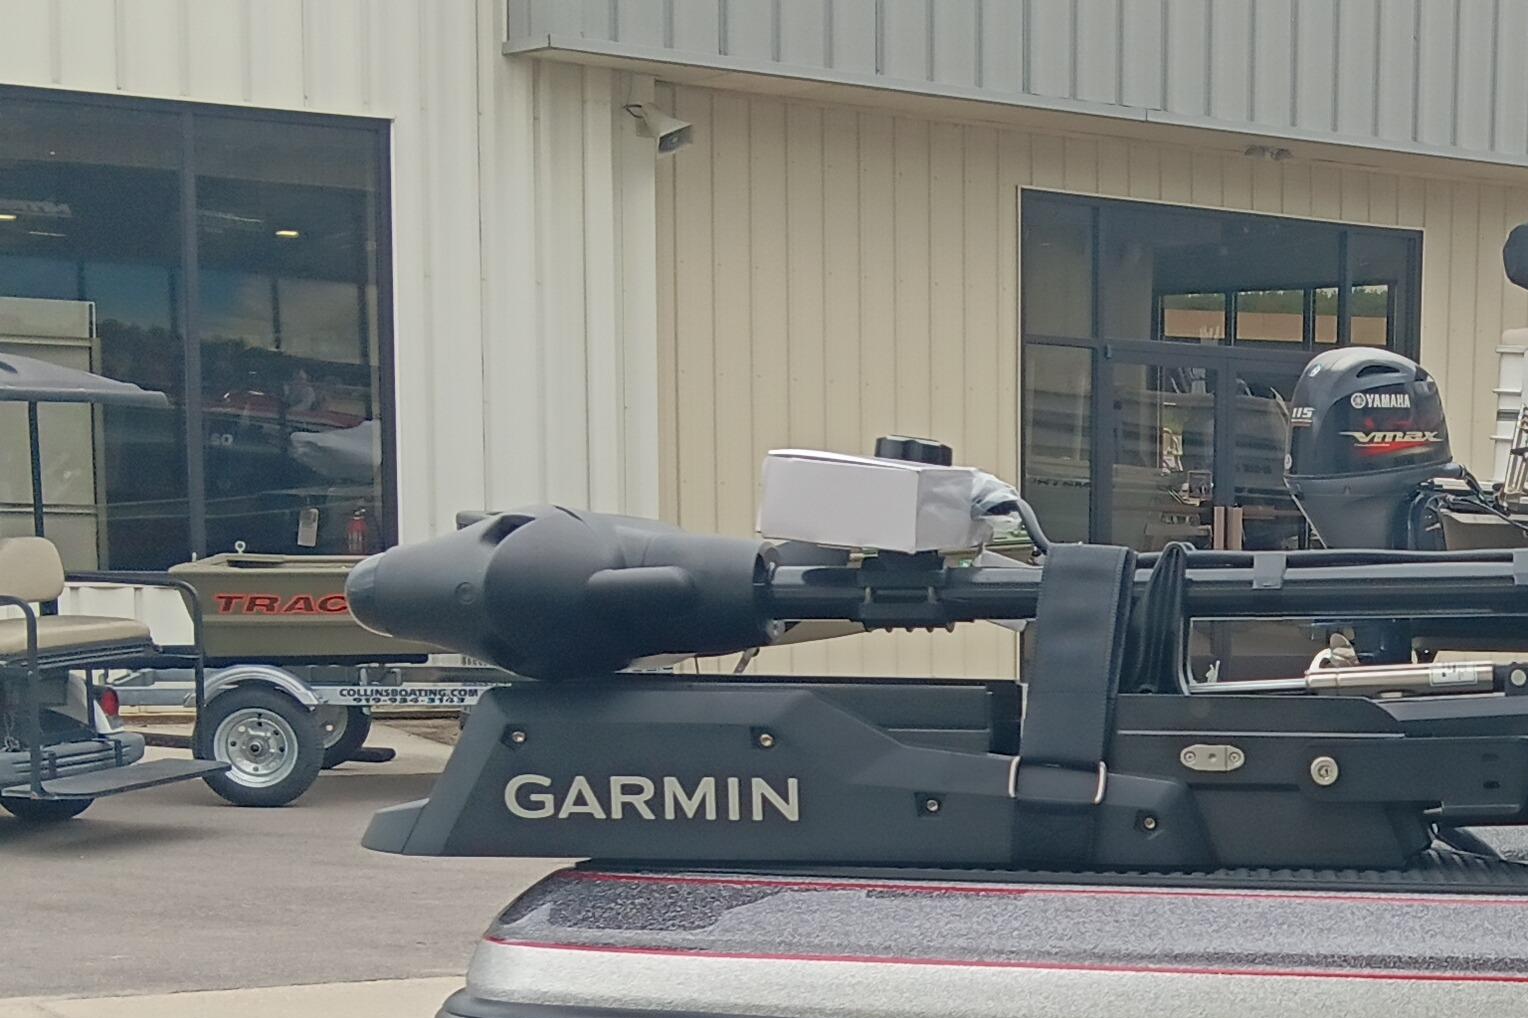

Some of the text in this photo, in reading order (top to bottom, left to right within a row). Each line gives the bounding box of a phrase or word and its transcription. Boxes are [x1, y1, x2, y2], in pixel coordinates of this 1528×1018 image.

[1366, 394, 1411, 408] YAMAHA
[1292, 407, 1315, 418] 115
[339, 688, 478, 698] COLLINSBOATING.COM
[504, 774, 799, 822] GARMIN
